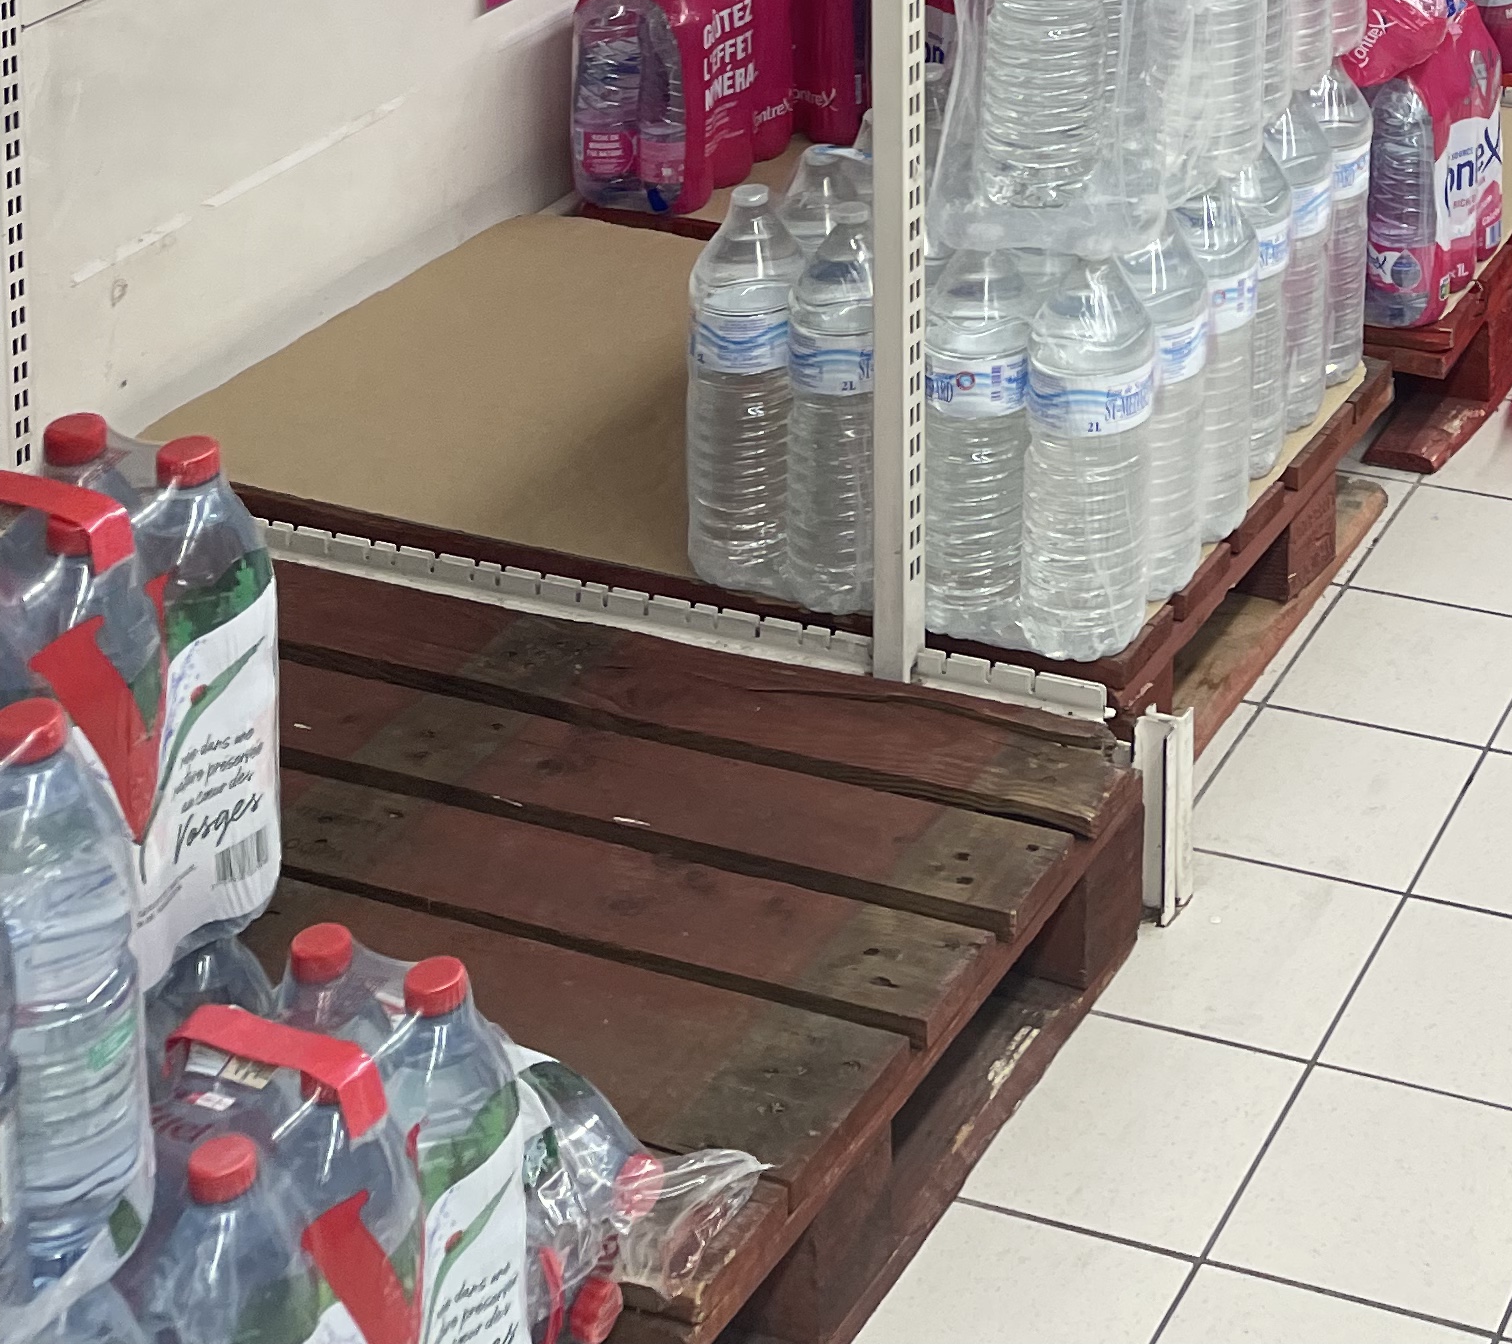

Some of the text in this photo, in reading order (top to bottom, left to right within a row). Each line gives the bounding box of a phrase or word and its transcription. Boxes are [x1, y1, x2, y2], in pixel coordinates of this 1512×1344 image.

[841, 380, 856, 392] 2L
[1086, 421, 1102, 433] 2L
[174, 791, 265, 865] Vosges
